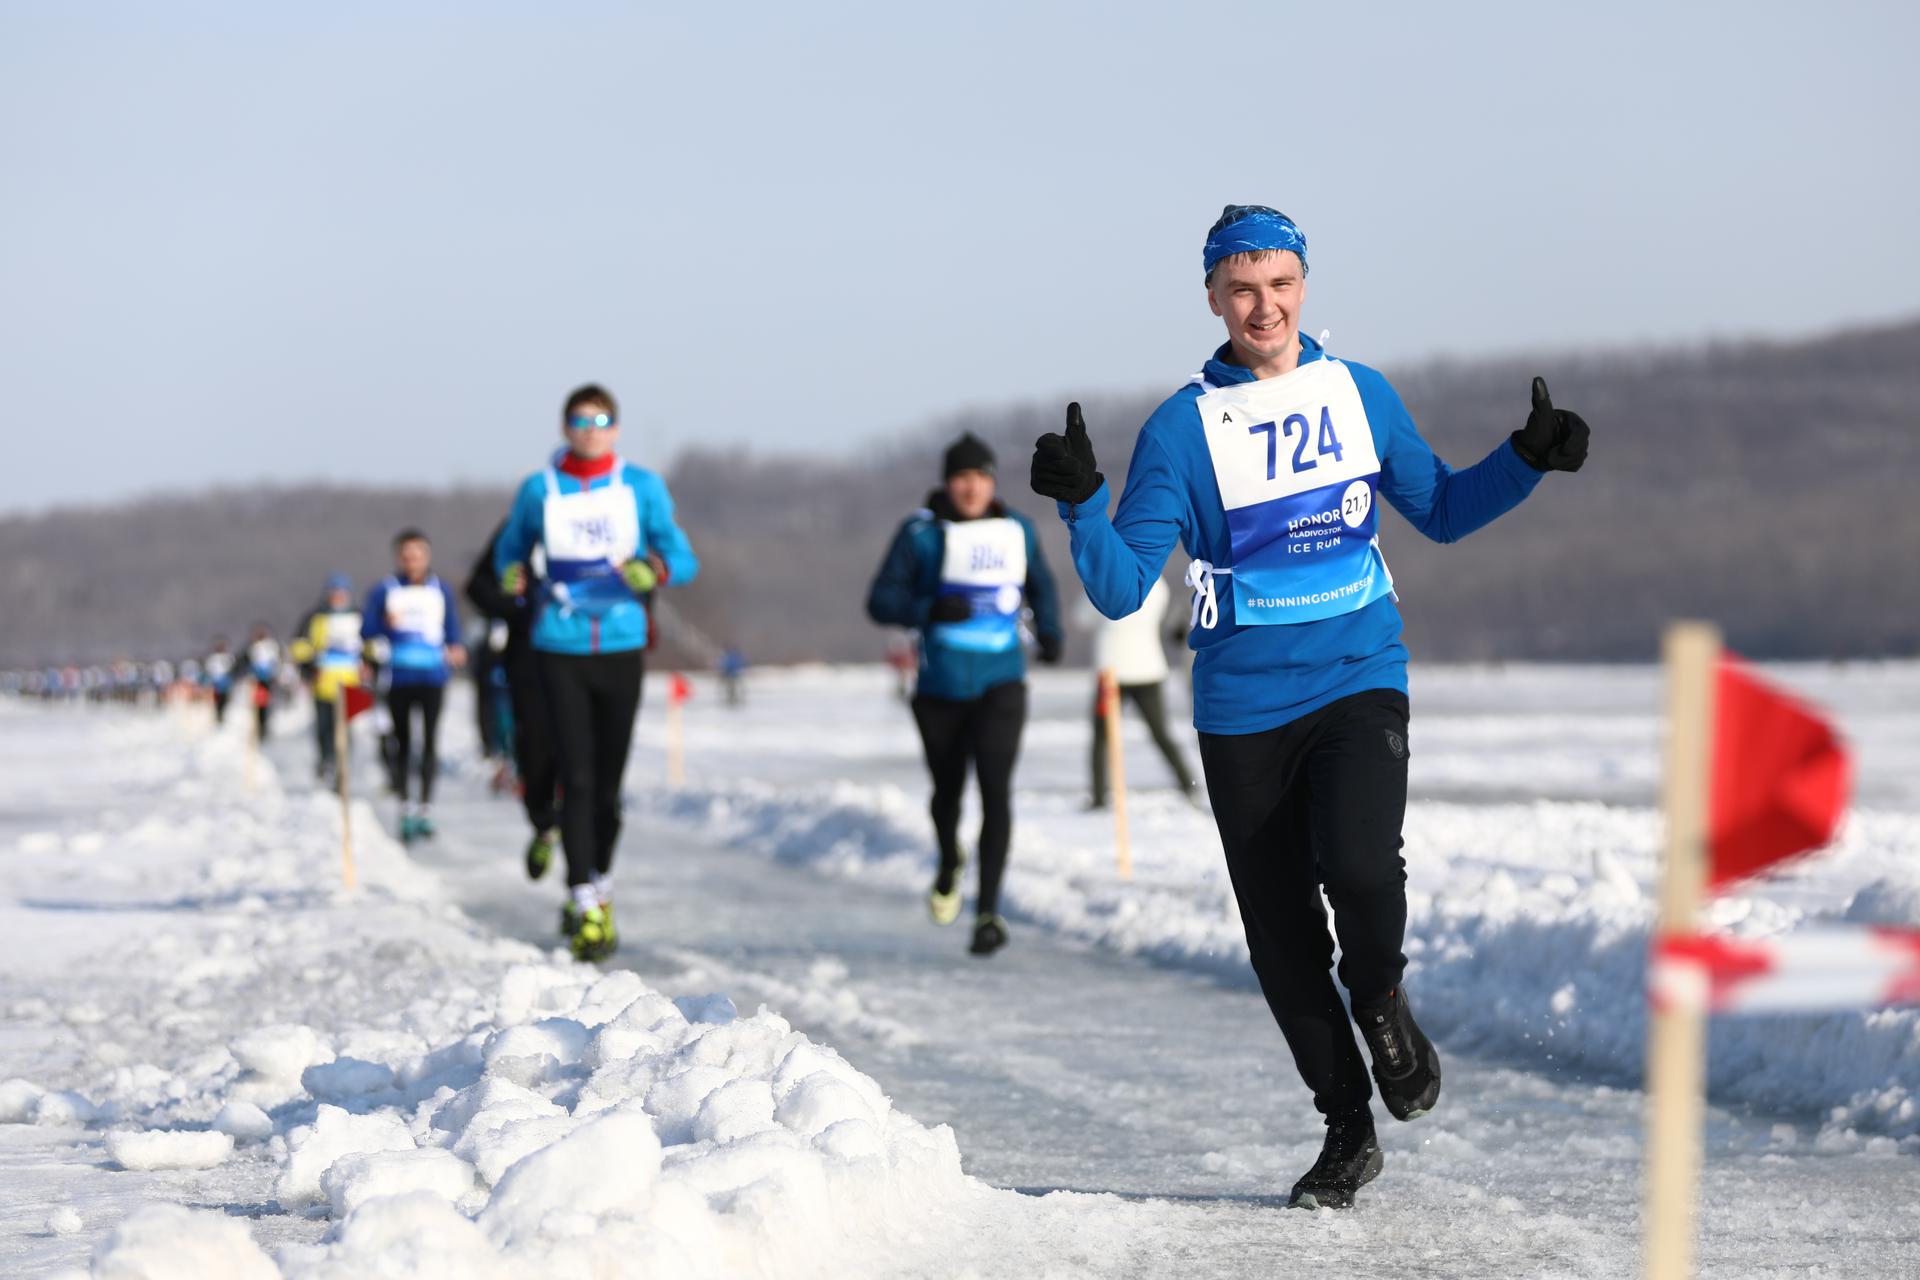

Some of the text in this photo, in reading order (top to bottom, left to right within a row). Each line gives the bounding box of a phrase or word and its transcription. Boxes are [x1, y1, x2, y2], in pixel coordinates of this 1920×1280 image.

[1222, 412, 1233, 424] A
[1248, 405, 1344, 481] 724
[1345, 492, 1369, 515] 21,1
[1288, 508, 1342, 532] HONOR
[1288, 526, 1343, 538] VLADIVOSTOK
[1288, 536, 1342, 554] ICE RUN
